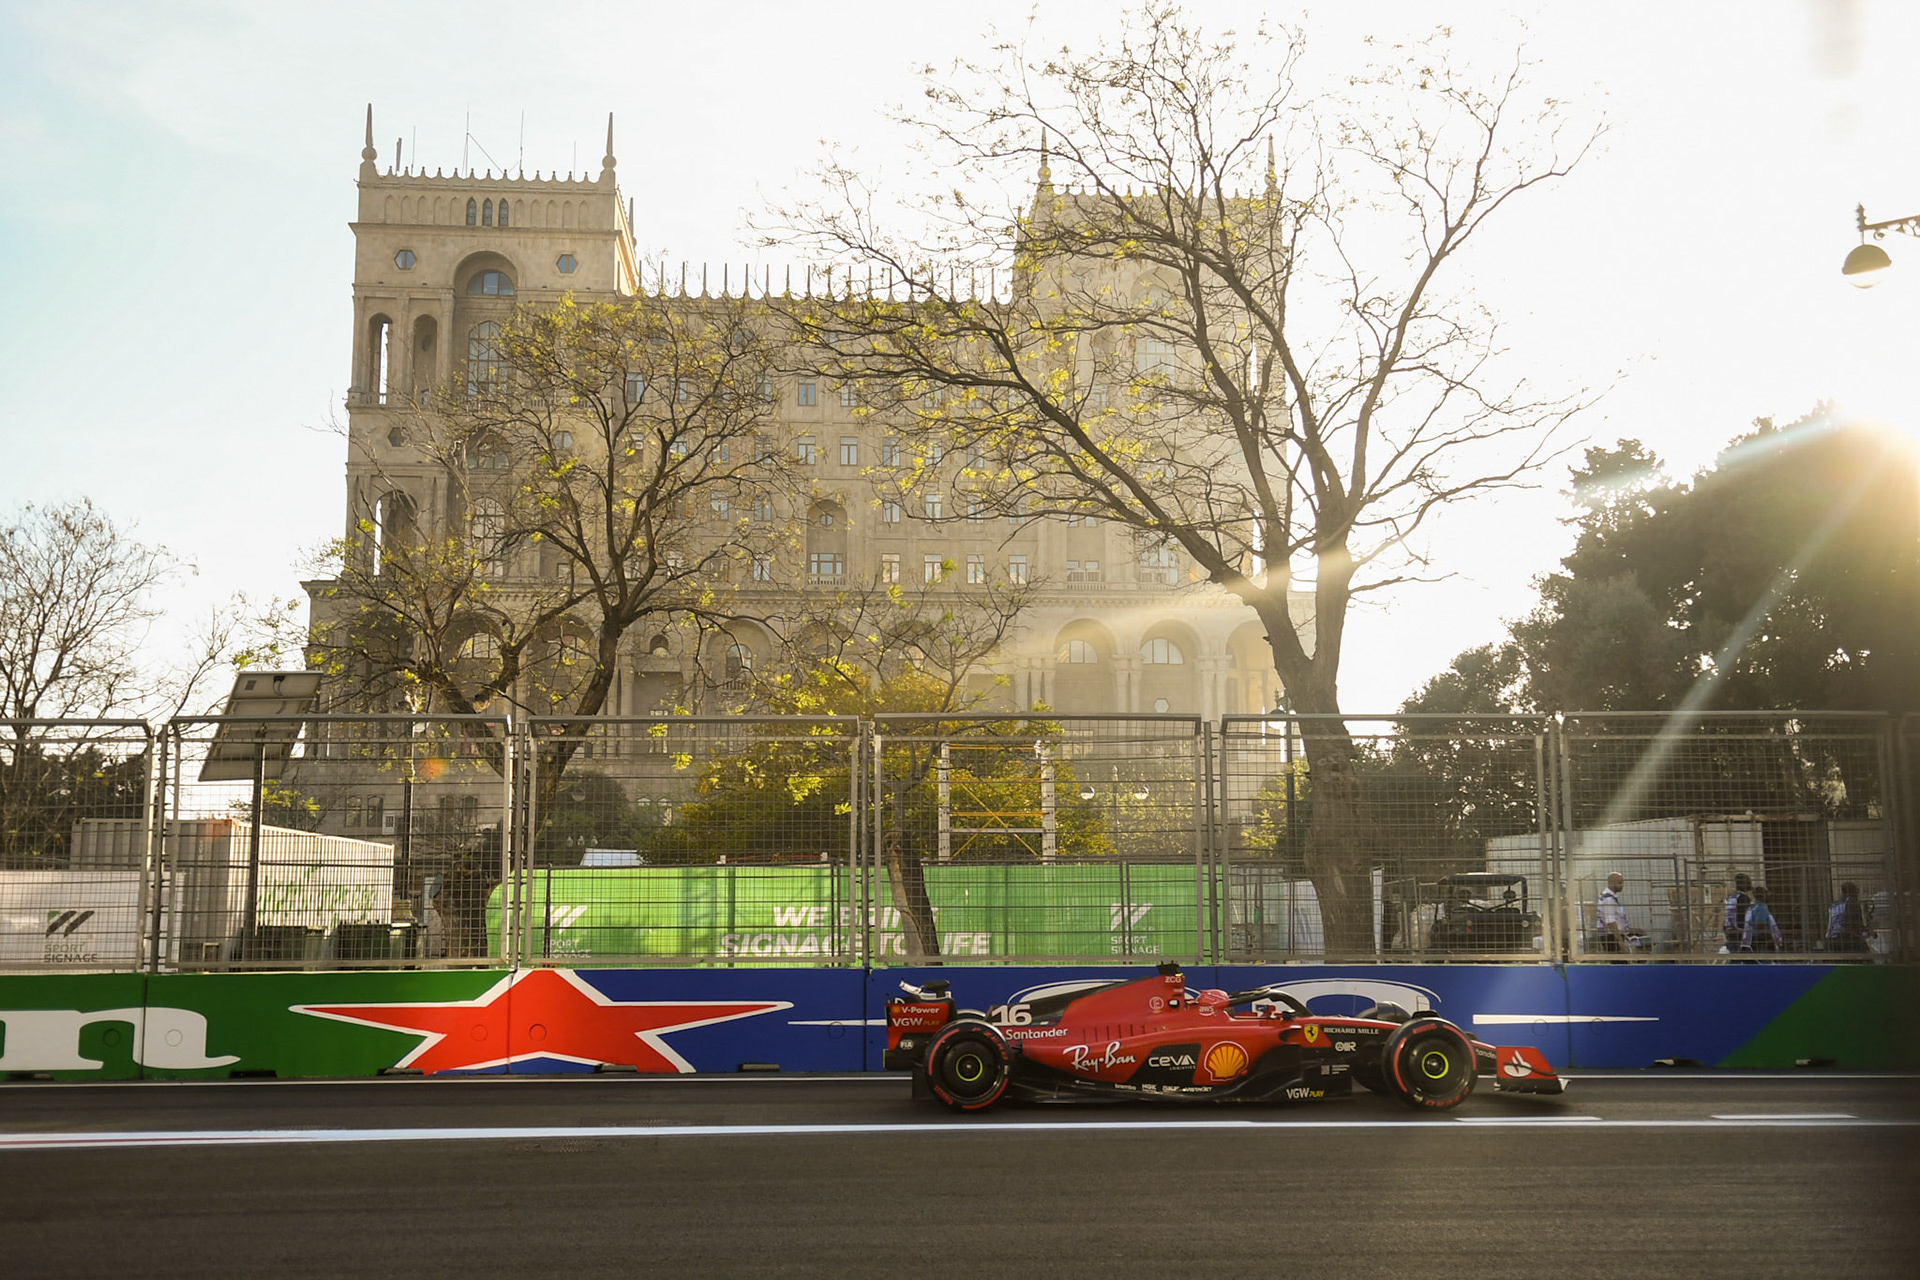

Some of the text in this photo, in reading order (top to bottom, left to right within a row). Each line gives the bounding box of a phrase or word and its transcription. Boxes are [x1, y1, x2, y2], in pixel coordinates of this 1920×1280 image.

[773, 906, 939, 928] WE BRI
[44, 944, 85, 953] SPORT
[720, 933, 863, 957] SIGNAGE
[941, 932, 991, 955] IFE
[44, 953, 98, 963] SIGNAGE
[1164, 976, 1182, 984] ZCG
[901, 1006, 940, 1014] V-Power
[991, 1004, 1033, 1026] 16
[892, 1018, 923, 1027] VGW
[1005, 1028, 1069, 1040] Santander
[1286, 1087, 1324, 1099] VGW PLAY
